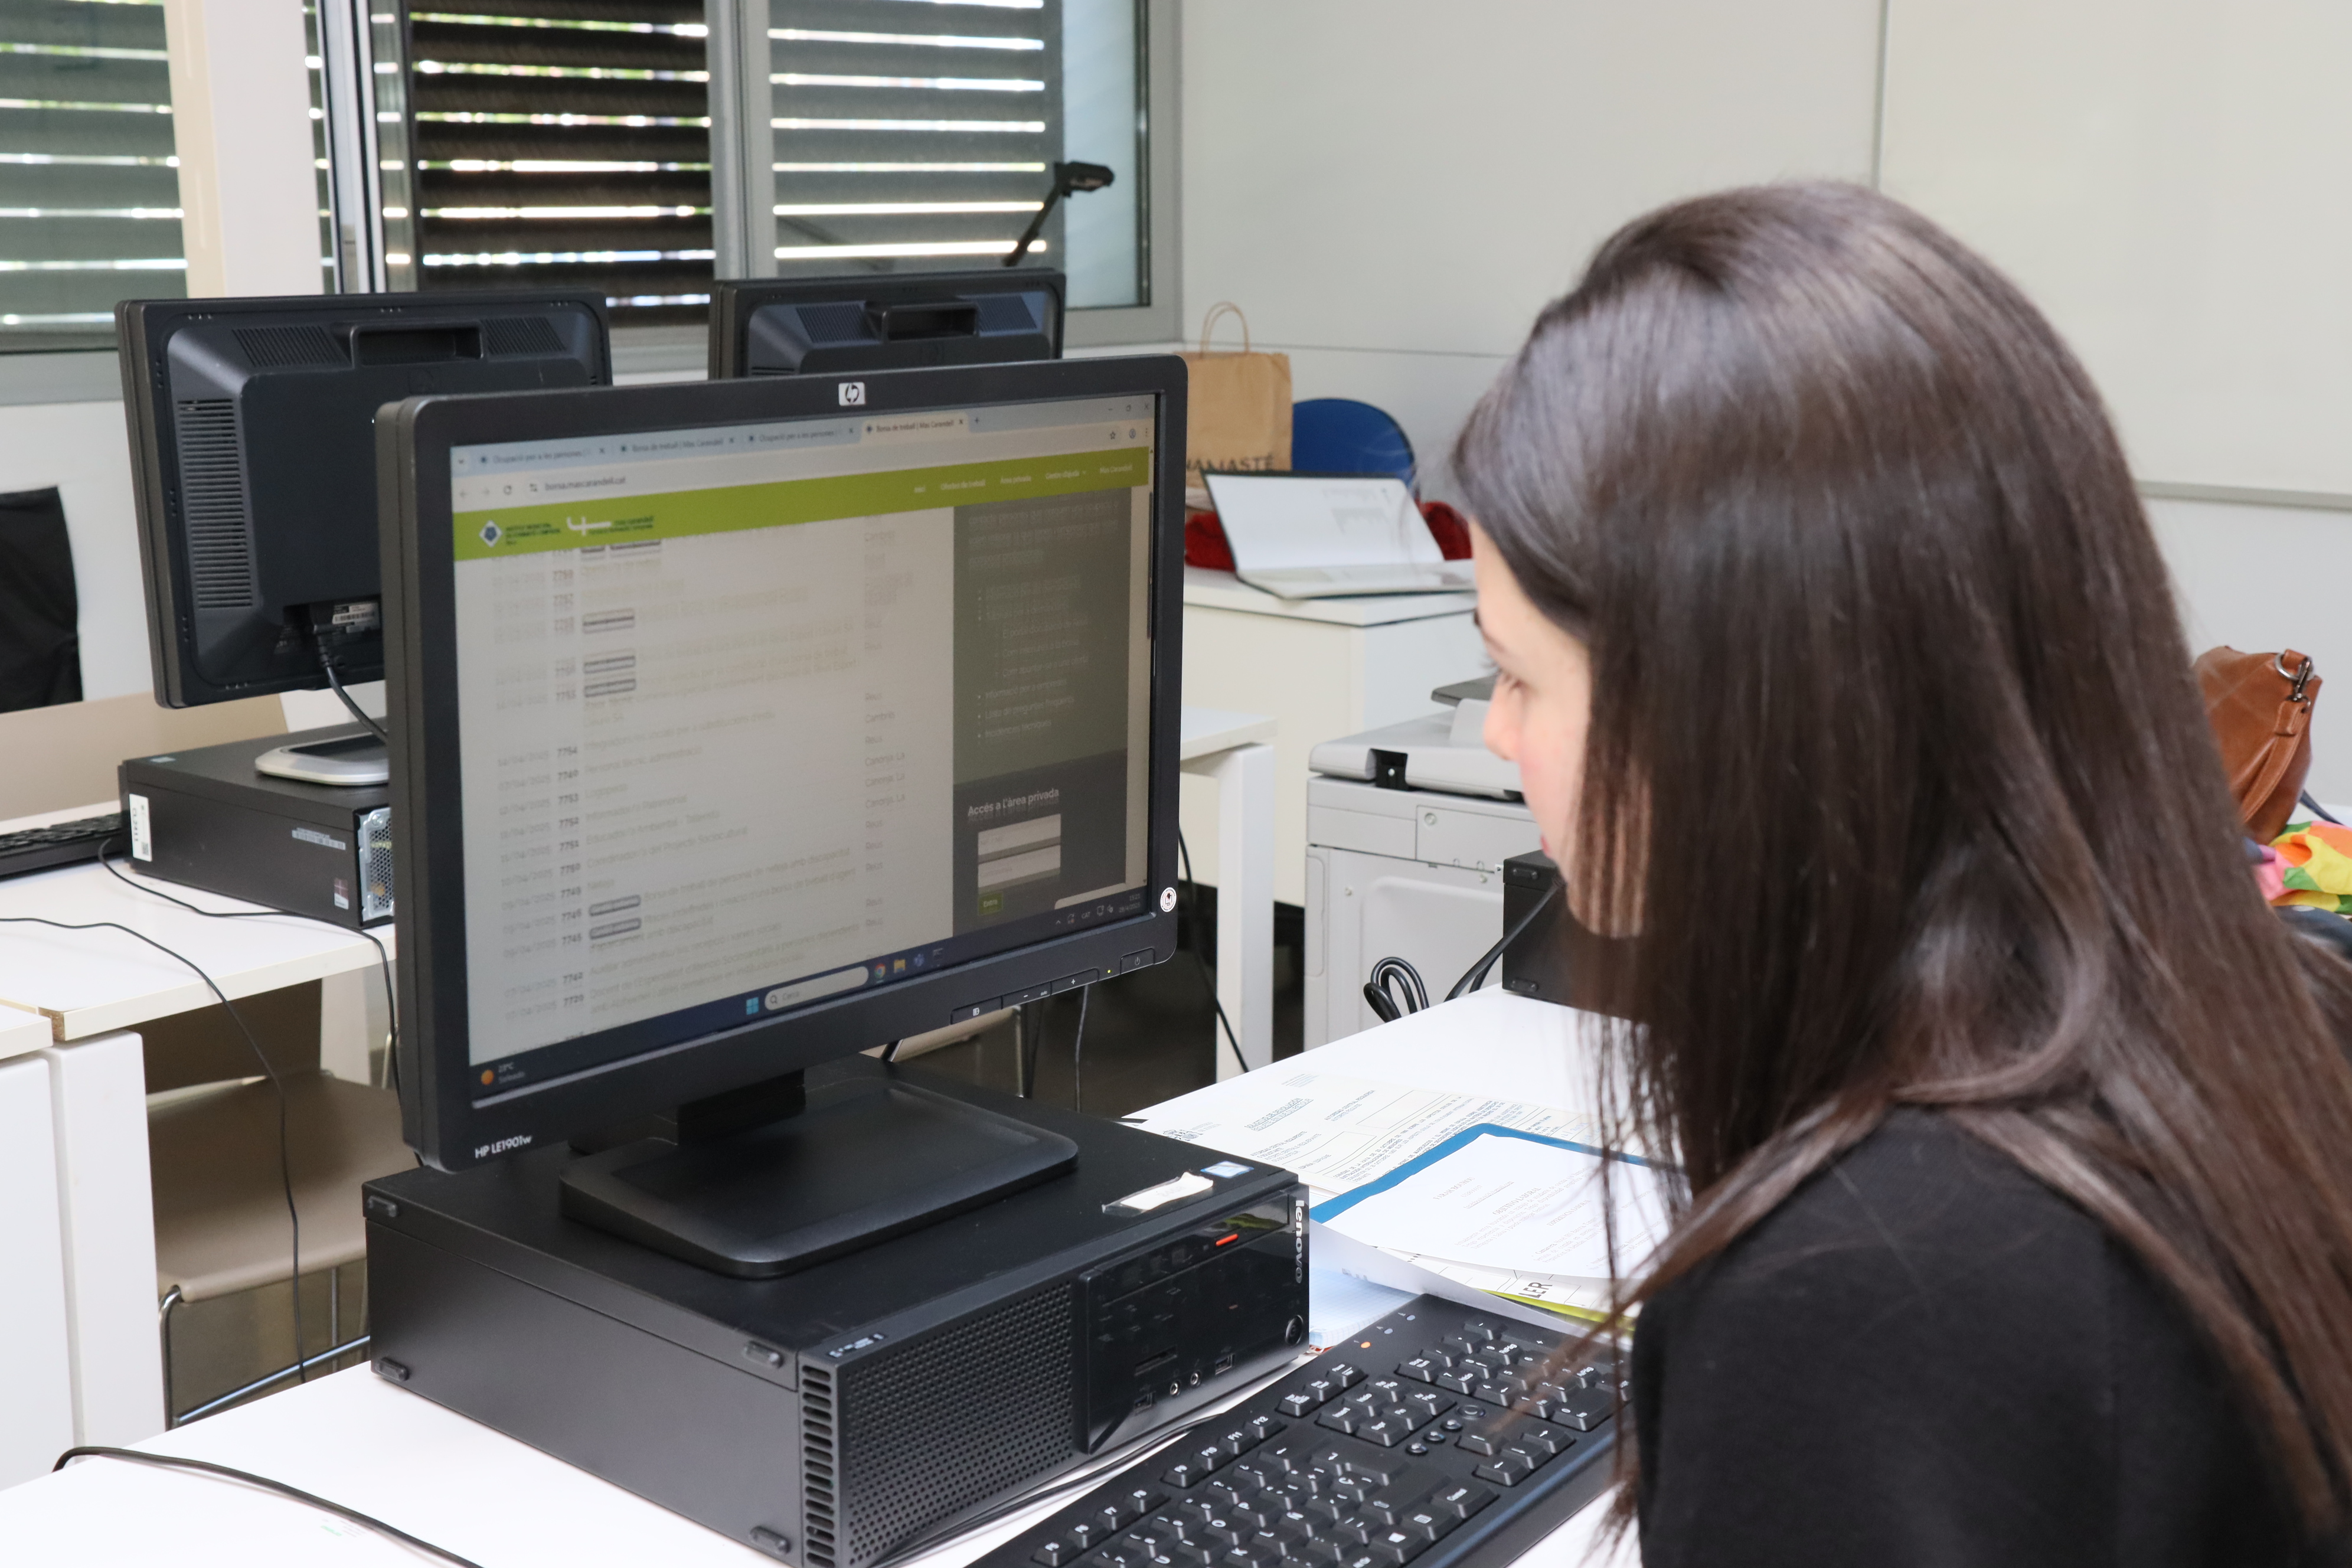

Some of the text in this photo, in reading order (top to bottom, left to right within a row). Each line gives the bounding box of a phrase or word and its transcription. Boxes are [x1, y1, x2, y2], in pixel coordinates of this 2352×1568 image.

[967, 801, 993, 817] Accés
[995, 801, 1001, 811] a
[1028, 785, 1059, 805] privada
[1270, 1097, 1304, 1113] DEVOLUCIÓN
[475, 1135, 533, 1159] HP LE1901w
[1295, 1200, 1305, 1283] lenovo
[1253, 1416, 1268, 1425] F12
[1201, 1446, 1217, 1456] F10
[1104, 1506, 1117, 1515] F7
[1211, 1519, 1226, 1528] O
[1231, 1547, 1249, 1556] K
[1154, 1555, 1171, 1564] U
